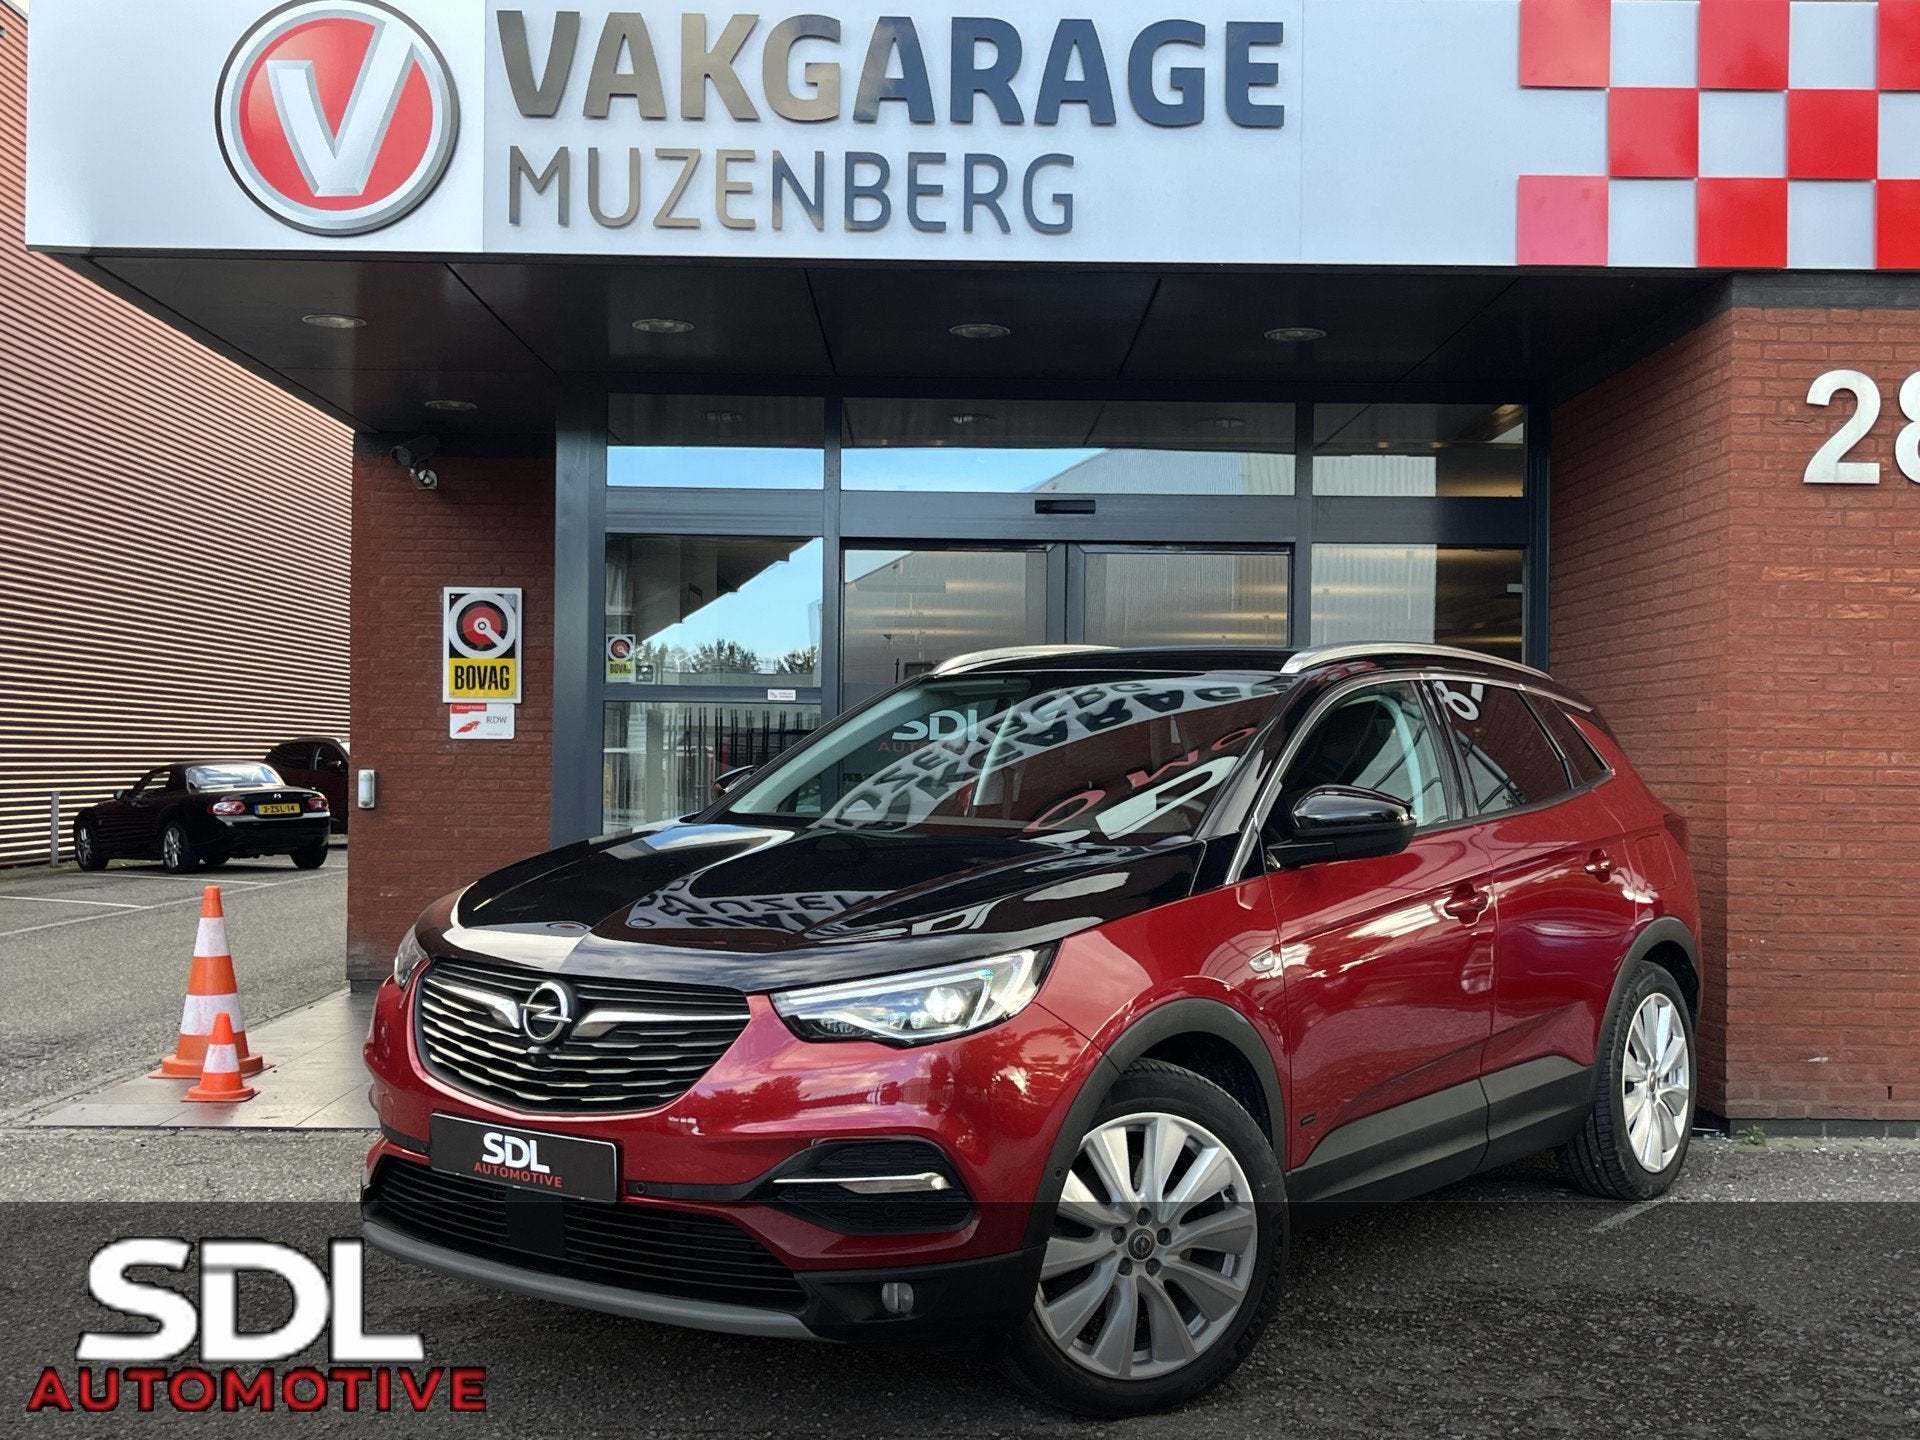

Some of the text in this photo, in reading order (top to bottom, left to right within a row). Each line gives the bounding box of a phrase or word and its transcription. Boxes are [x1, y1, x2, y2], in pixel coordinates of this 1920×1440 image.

[497, 10, 1285, 127] VAKGARAGE
[508, 145, 1075, 233] MUZENBERG
[454, 665, 510, 691] BOVAG
[486, 716, 507, 724] RDW
[481, 1131, 550, 1173] SDL
[474, 1162, 563, 1188] AUTOMOTIVE
